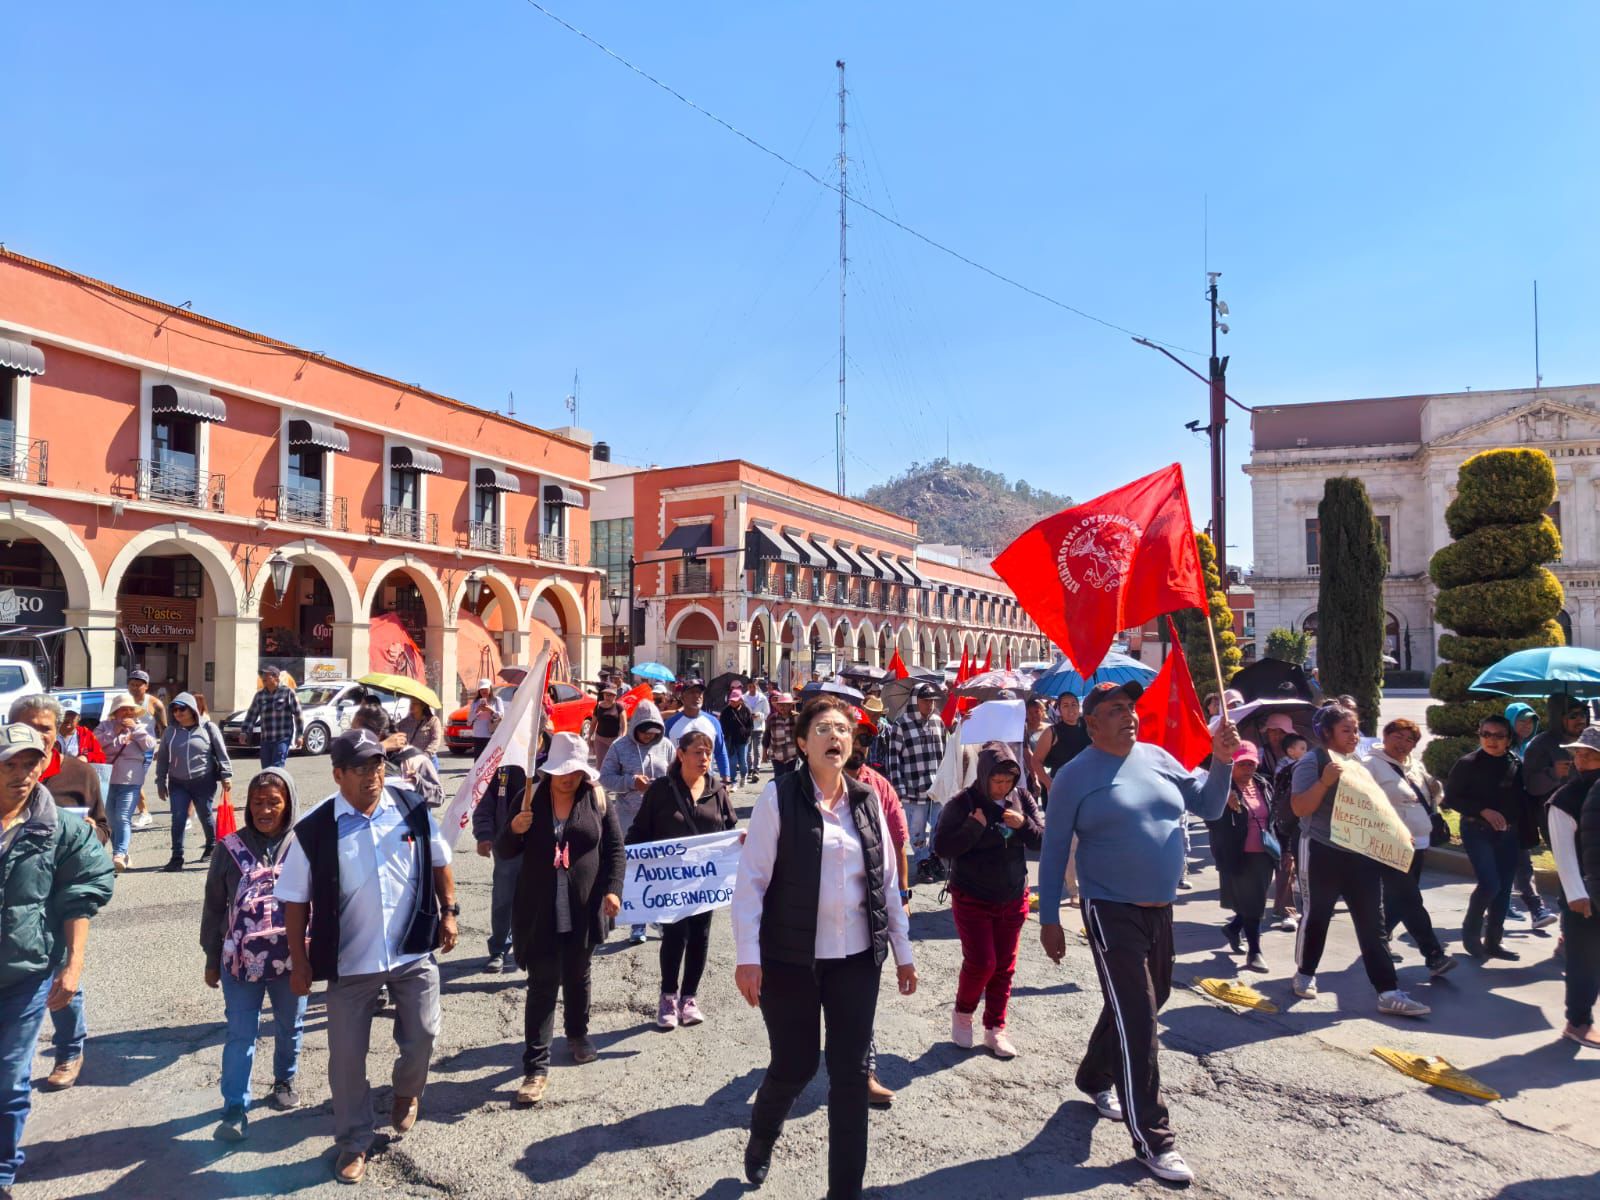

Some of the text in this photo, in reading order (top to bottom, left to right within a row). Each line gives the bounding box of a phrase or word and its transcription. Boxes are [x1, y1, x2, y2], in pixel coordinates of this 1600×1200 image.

[144, 606, 182, 620] Pastes
[150, 624, 160, 634] de
[625, 843, 688, 860] XIGIMOS
[634, 861, 718, 882] AUDIENCIA
